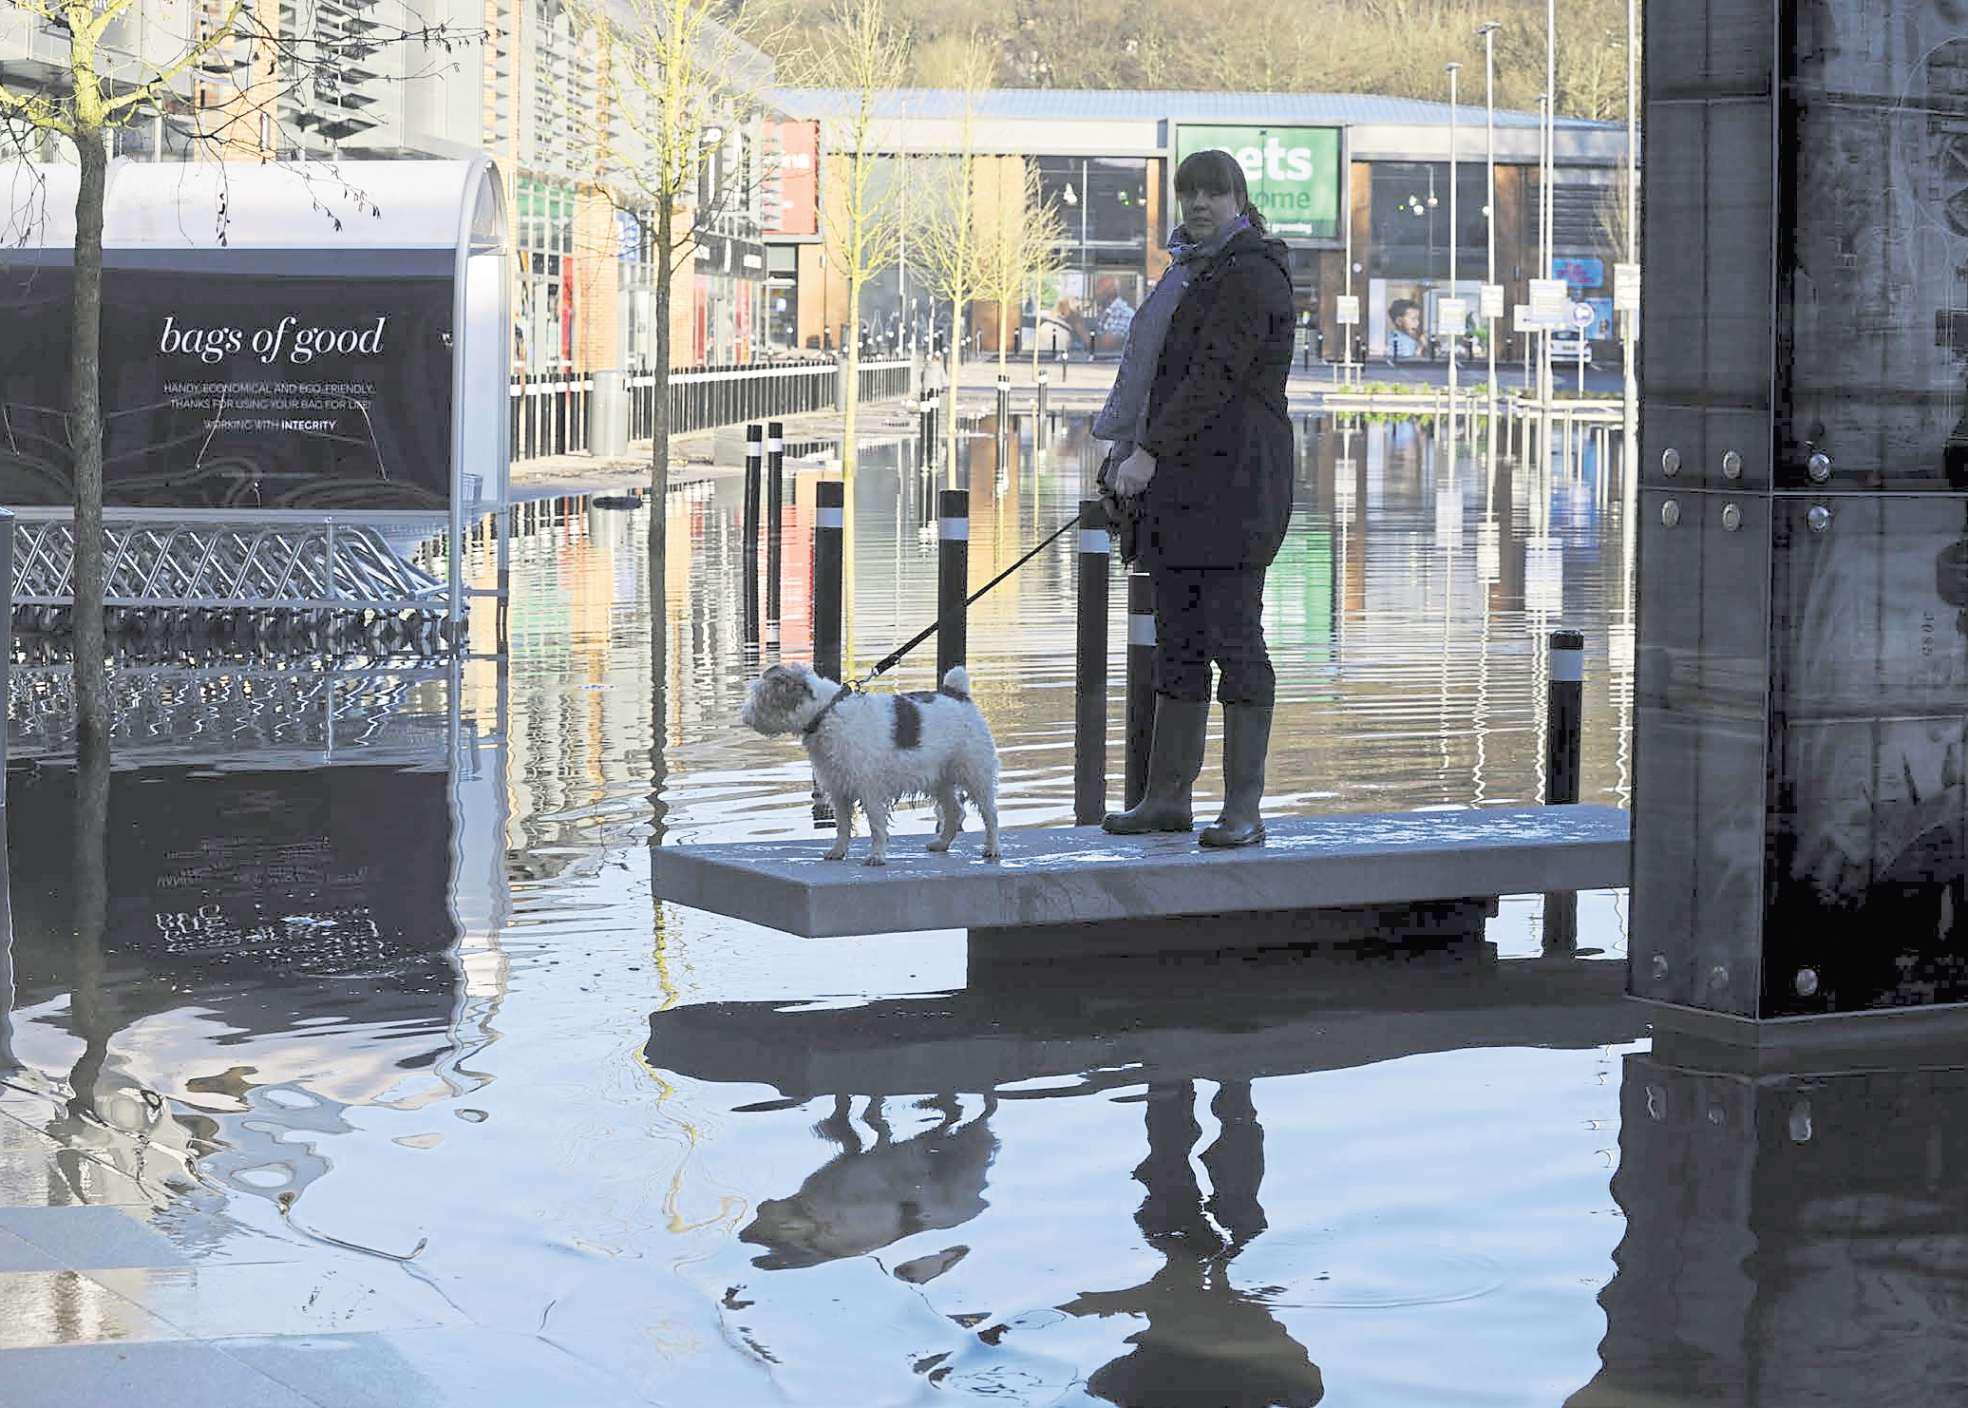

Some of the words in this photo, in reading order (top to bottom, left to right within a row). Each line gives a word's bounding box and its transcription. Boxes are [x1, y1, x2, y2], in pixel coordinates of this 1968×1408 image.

[1202, 137, 1313, 181] ets
[1249, 191, 1311, 209] ome
[161, 316, 243, 363] bags
[252, 316, 297, 363] of
[290, 316, 386, 364] good
[274, 383, 298, 394] AND
[170, 399, 209, 409] THANKS
[235, 399, 270, 410] USING
[271, 399, 301, 410] YOUR
[325, 399, 345, 410] FOR
[281, 420, 337, 430] INTEGRITY
